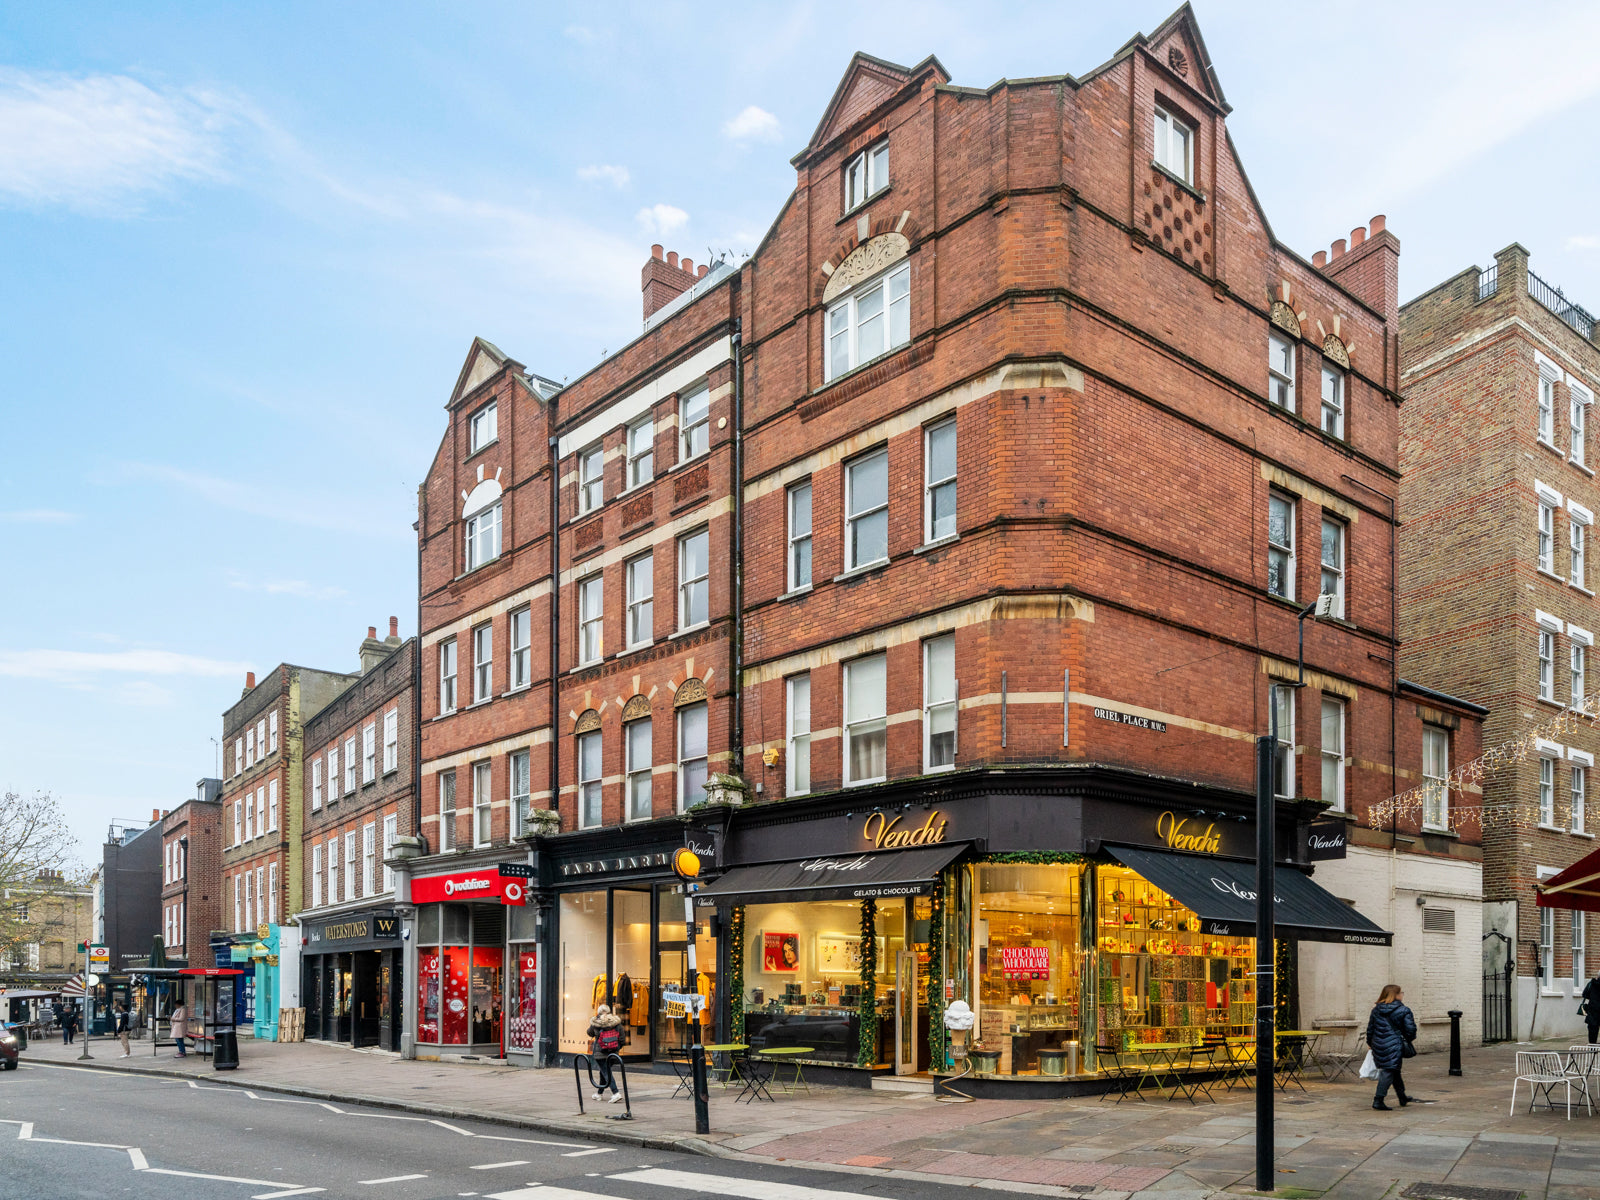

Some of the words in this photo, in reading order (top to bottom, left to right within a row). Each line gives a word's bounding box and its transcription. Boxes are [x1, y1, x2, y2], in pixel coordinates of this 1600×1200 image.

[1094, 708, 1120, 722] ORIEL
[1123, 714, 1149, 728] PLACE
[863, 811, 946, 848] Venchi
[1156, 811, 1222, 853] Venchi
[1308, 834, 1344, 849] Venchi
[687, 840, 715, 857] Venchi
[560, 861, 607, 875] TARA
[615, 853, 668, 870] JARM
[454, 879, 490, 891] vodafone
[883, 886, 921, 895] CHOCOLATE
[1211, 877, 1285, 902] Veni
[697, 898, 715, 906] Venchi
[324, 920, 368, 940] WATERSTONES
[377, 919, 395, 931] W
[1210, 923, 1230, 935] Venchi
[1363, 936, 1386, 944] CHOCOLATE
[1003, 948, 1049, 959] CHOCOVIAR
[668, 1002, 685, 1010] BLACK
